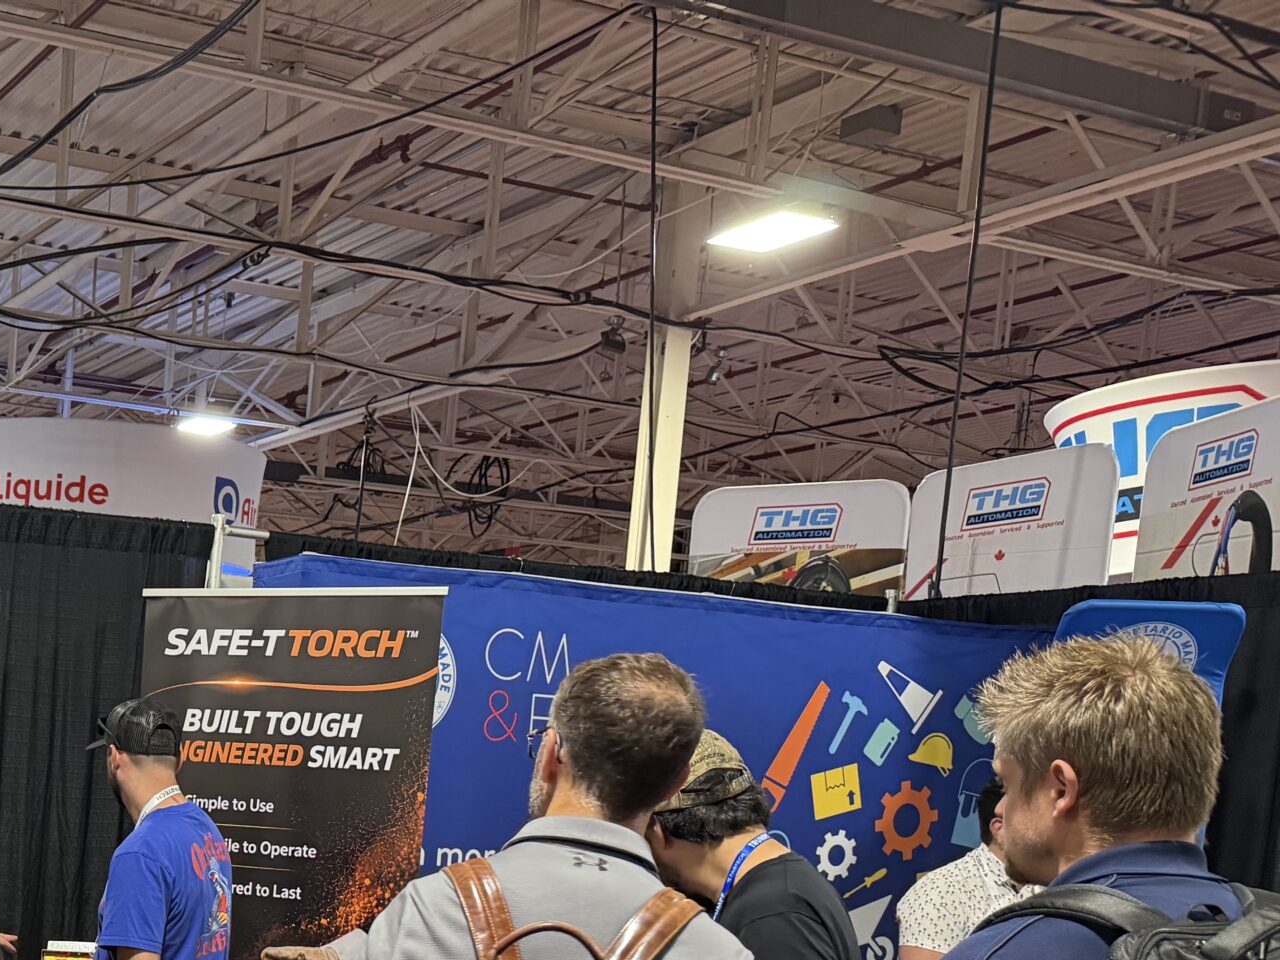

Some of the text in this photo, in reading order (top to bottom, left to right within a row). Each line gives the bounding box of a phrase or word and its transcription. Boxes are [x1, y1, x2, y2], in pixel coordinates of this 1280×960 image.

[1199, 435, 1255, 468] THG
[1194, 462, 1249, 482] AUTOMATION
[972, 483, 1046, 511] THG
[241, 499, 257, 527] Air
[760, 508, 838, 528] THG
[967, 507, 1039, 524] AUTOMATION
[1037, 520, 1065, 529] Supported
[756, 529, 831, 540] AUTOMATION
[825, 543, 857, 551] Supported
[164, 628, 286, 656] SAFE-T
[485, 628, 569, 684] CM
[438, 646, 451, 695] MADE
[183, 708, 362, 738] BUILT TOUGH
[484, 690, 517, 742] &
[181, 740, 400, 771] NGINEERED SMART
[232, 799, 246, 812] to
[250, 798, 274, 813] Use
[243, 841, 257, 854] to
[260, 841, 317, 859] Operate
[255, 883, 270, 897] to
[273, 885, 301, 900] Last
